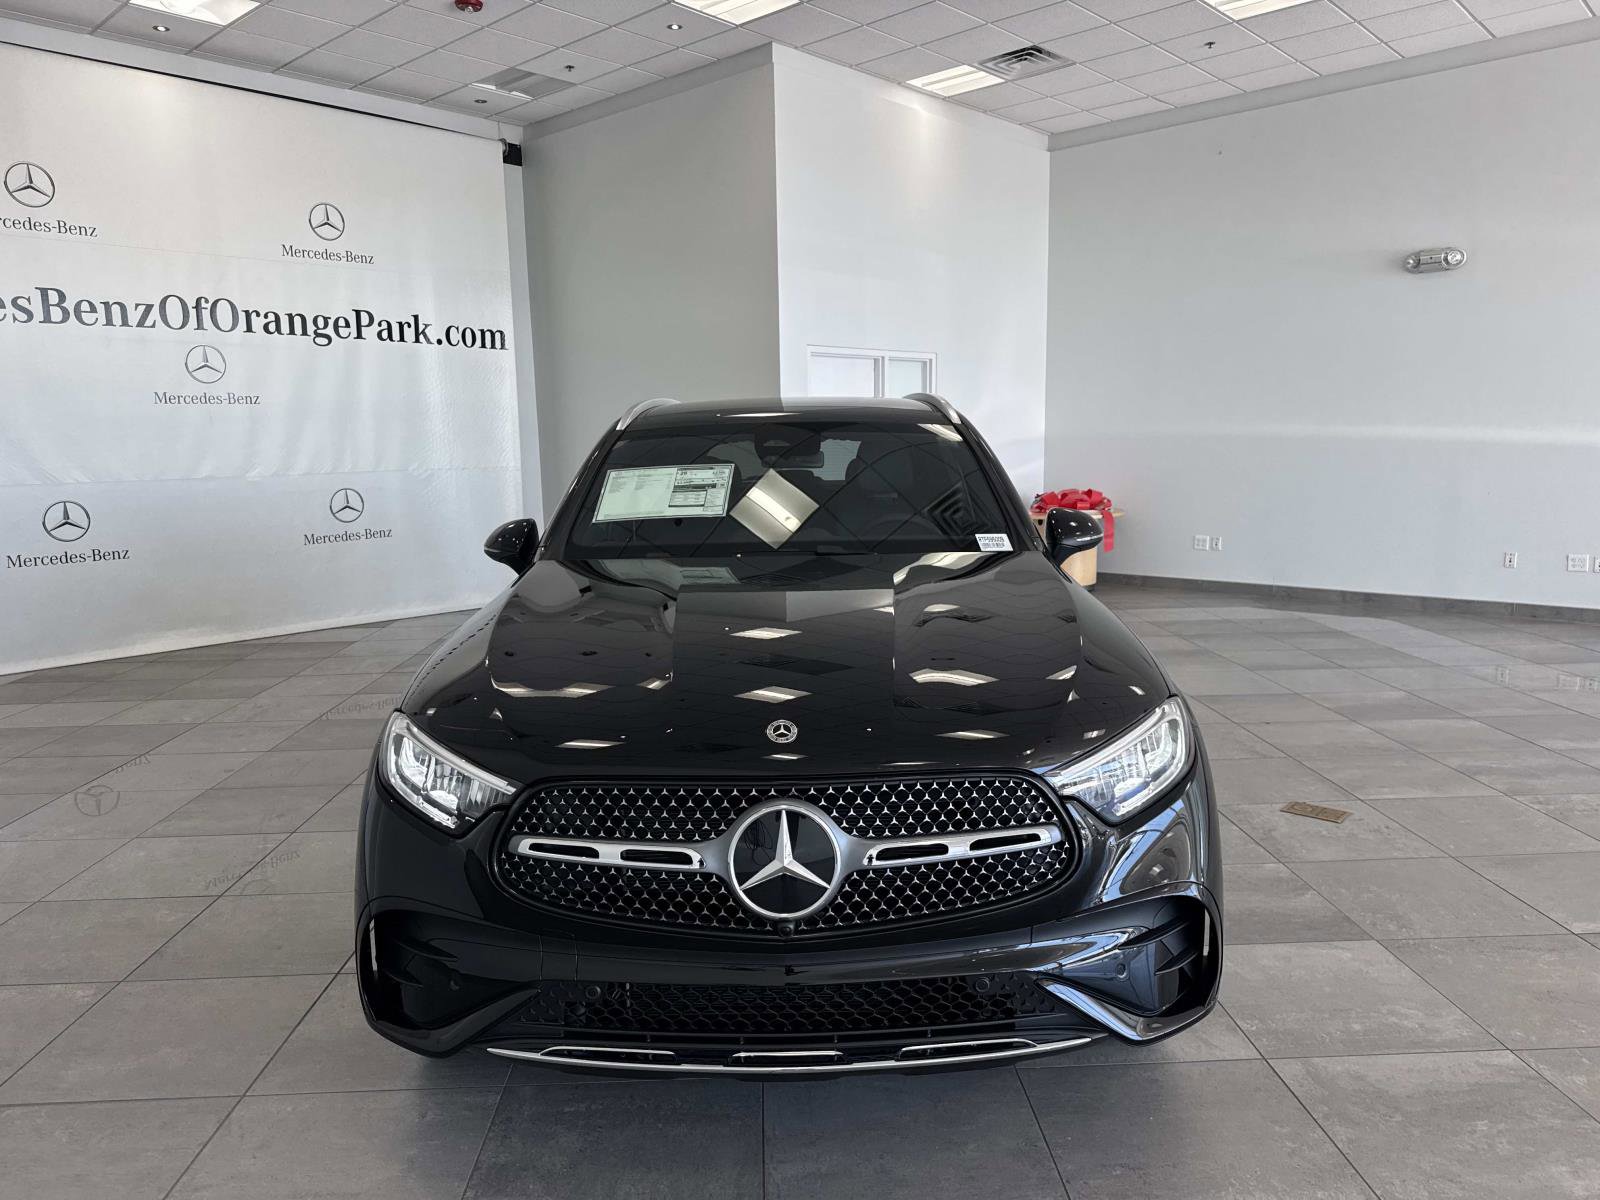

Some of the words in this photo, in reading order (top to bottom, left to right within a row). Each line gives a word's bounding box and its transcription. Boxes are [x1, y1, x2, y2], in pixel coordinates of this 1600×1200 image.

[281, 244, 375, 265] Mercedes-Benz
[0, 286, 508, 351] sBenzOfOrangePark.com
[153, 391, 261, 405] Mercedes-Benz
[303, 527, 393, 546] Mercedes-Benz
[6, 547, 130, 569] Mercedes-Benz
